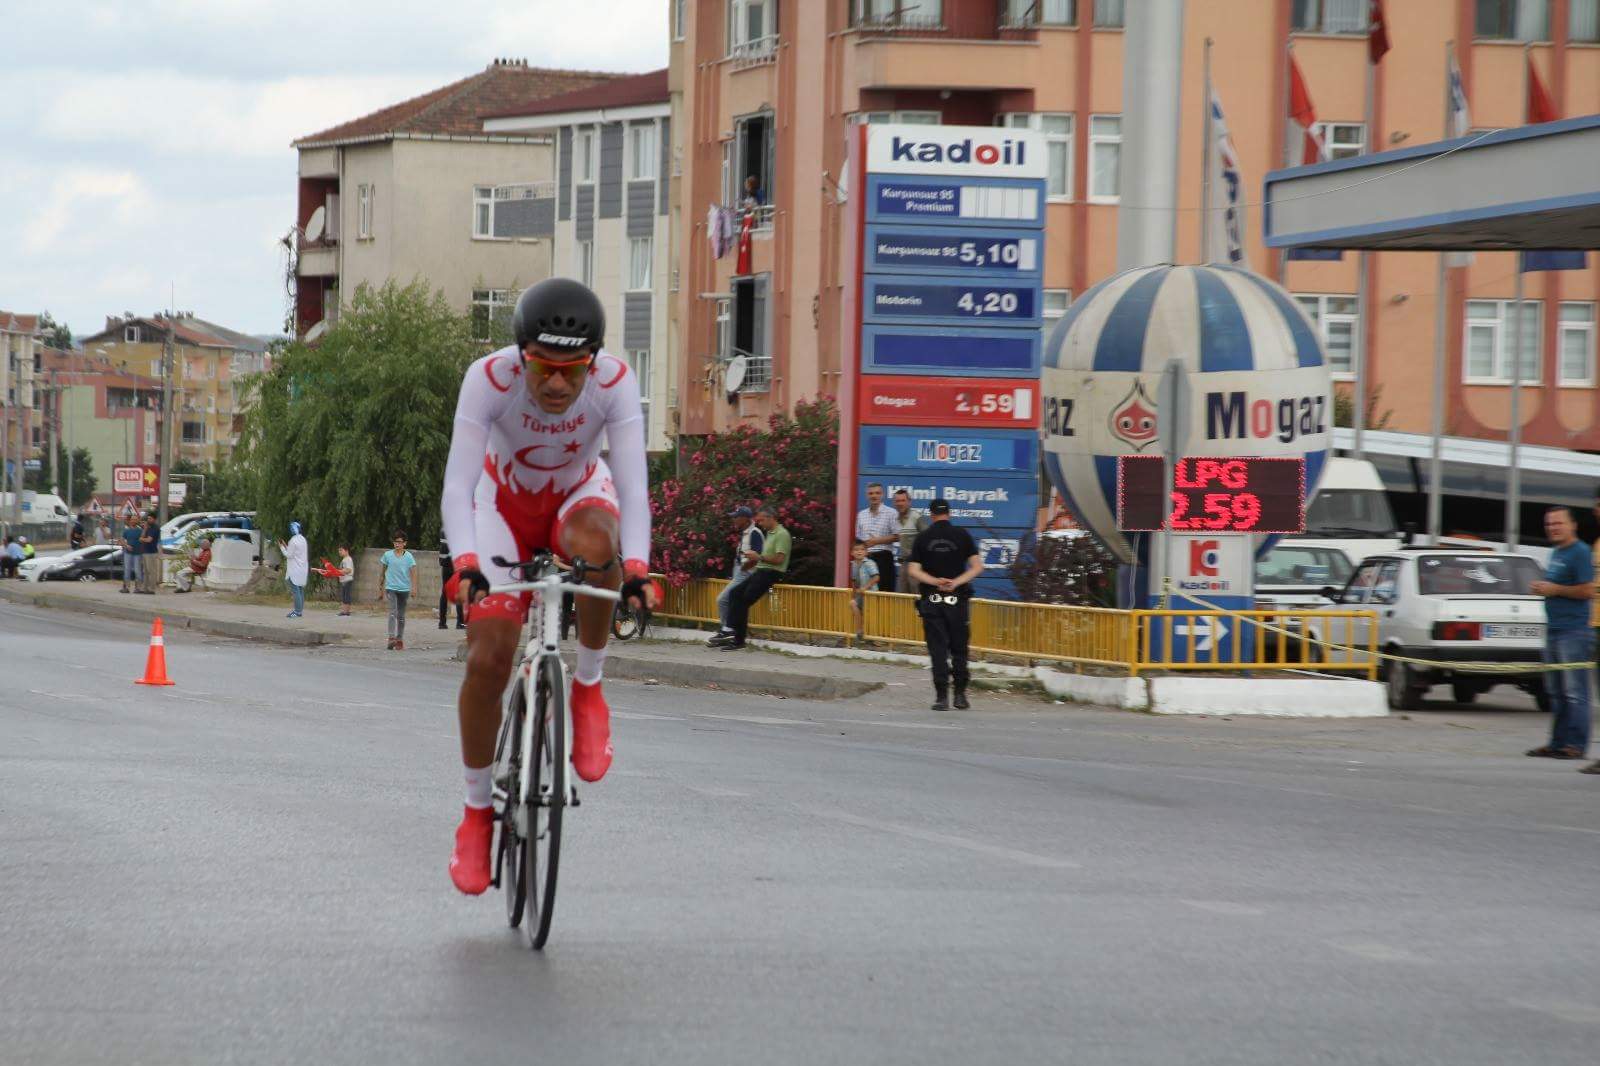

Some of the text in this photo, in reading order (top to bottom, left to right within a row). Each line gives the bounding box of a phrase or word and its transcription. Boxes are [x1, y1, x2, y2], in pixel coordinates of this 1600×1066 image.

[892, 136, 1026, 166] kadoil
[906, 201, 954, 212] Premium
[939, 189, 955, 201] 95
[942, 246, 958, 257] 95
[959, 242, 1019, 265] 5,10
[875, 292, 1018, 315] Motorin 4,20
[873, 392, 1014, 416] Otogaz 2,59
[521, 412, 586, 435] Türkiye
[1043, 397, 1076, 439] az
[1207, 391, 1327, 443] Mogaz
[917, 438, 982, 464] Mogaz
[1174, 460, 1250, 489] LPG
[943, 486, 1009, 505] Bayrak
[1169, 492, 1262, 530] 2.59
